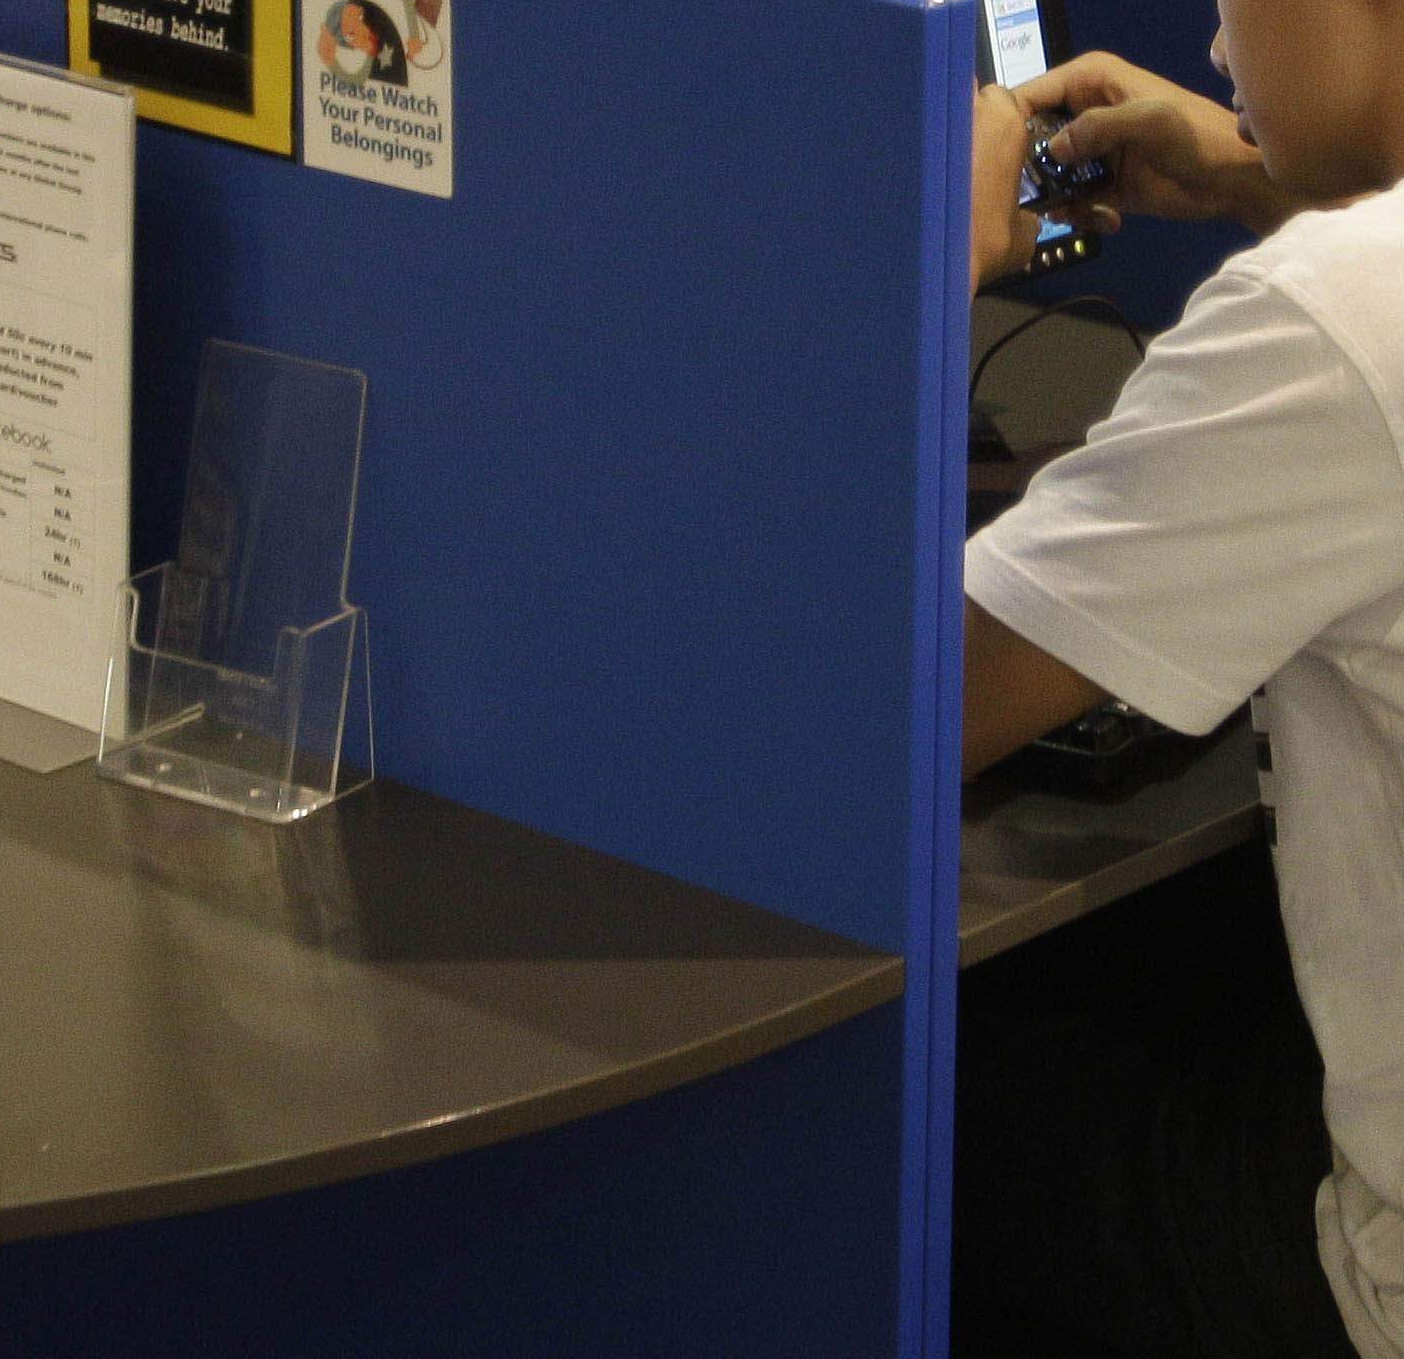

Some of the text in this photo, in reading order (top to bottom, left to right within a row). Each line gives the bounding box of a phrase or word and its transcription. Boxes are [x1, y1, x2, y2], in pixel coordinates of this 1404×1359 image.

[95, 2, 230, 52] memories behind.
[319, 71, 439, 118] Please Watch
[318, 96, 443, 144] Your Personal
[330, 125, 435, 171] Belongings
